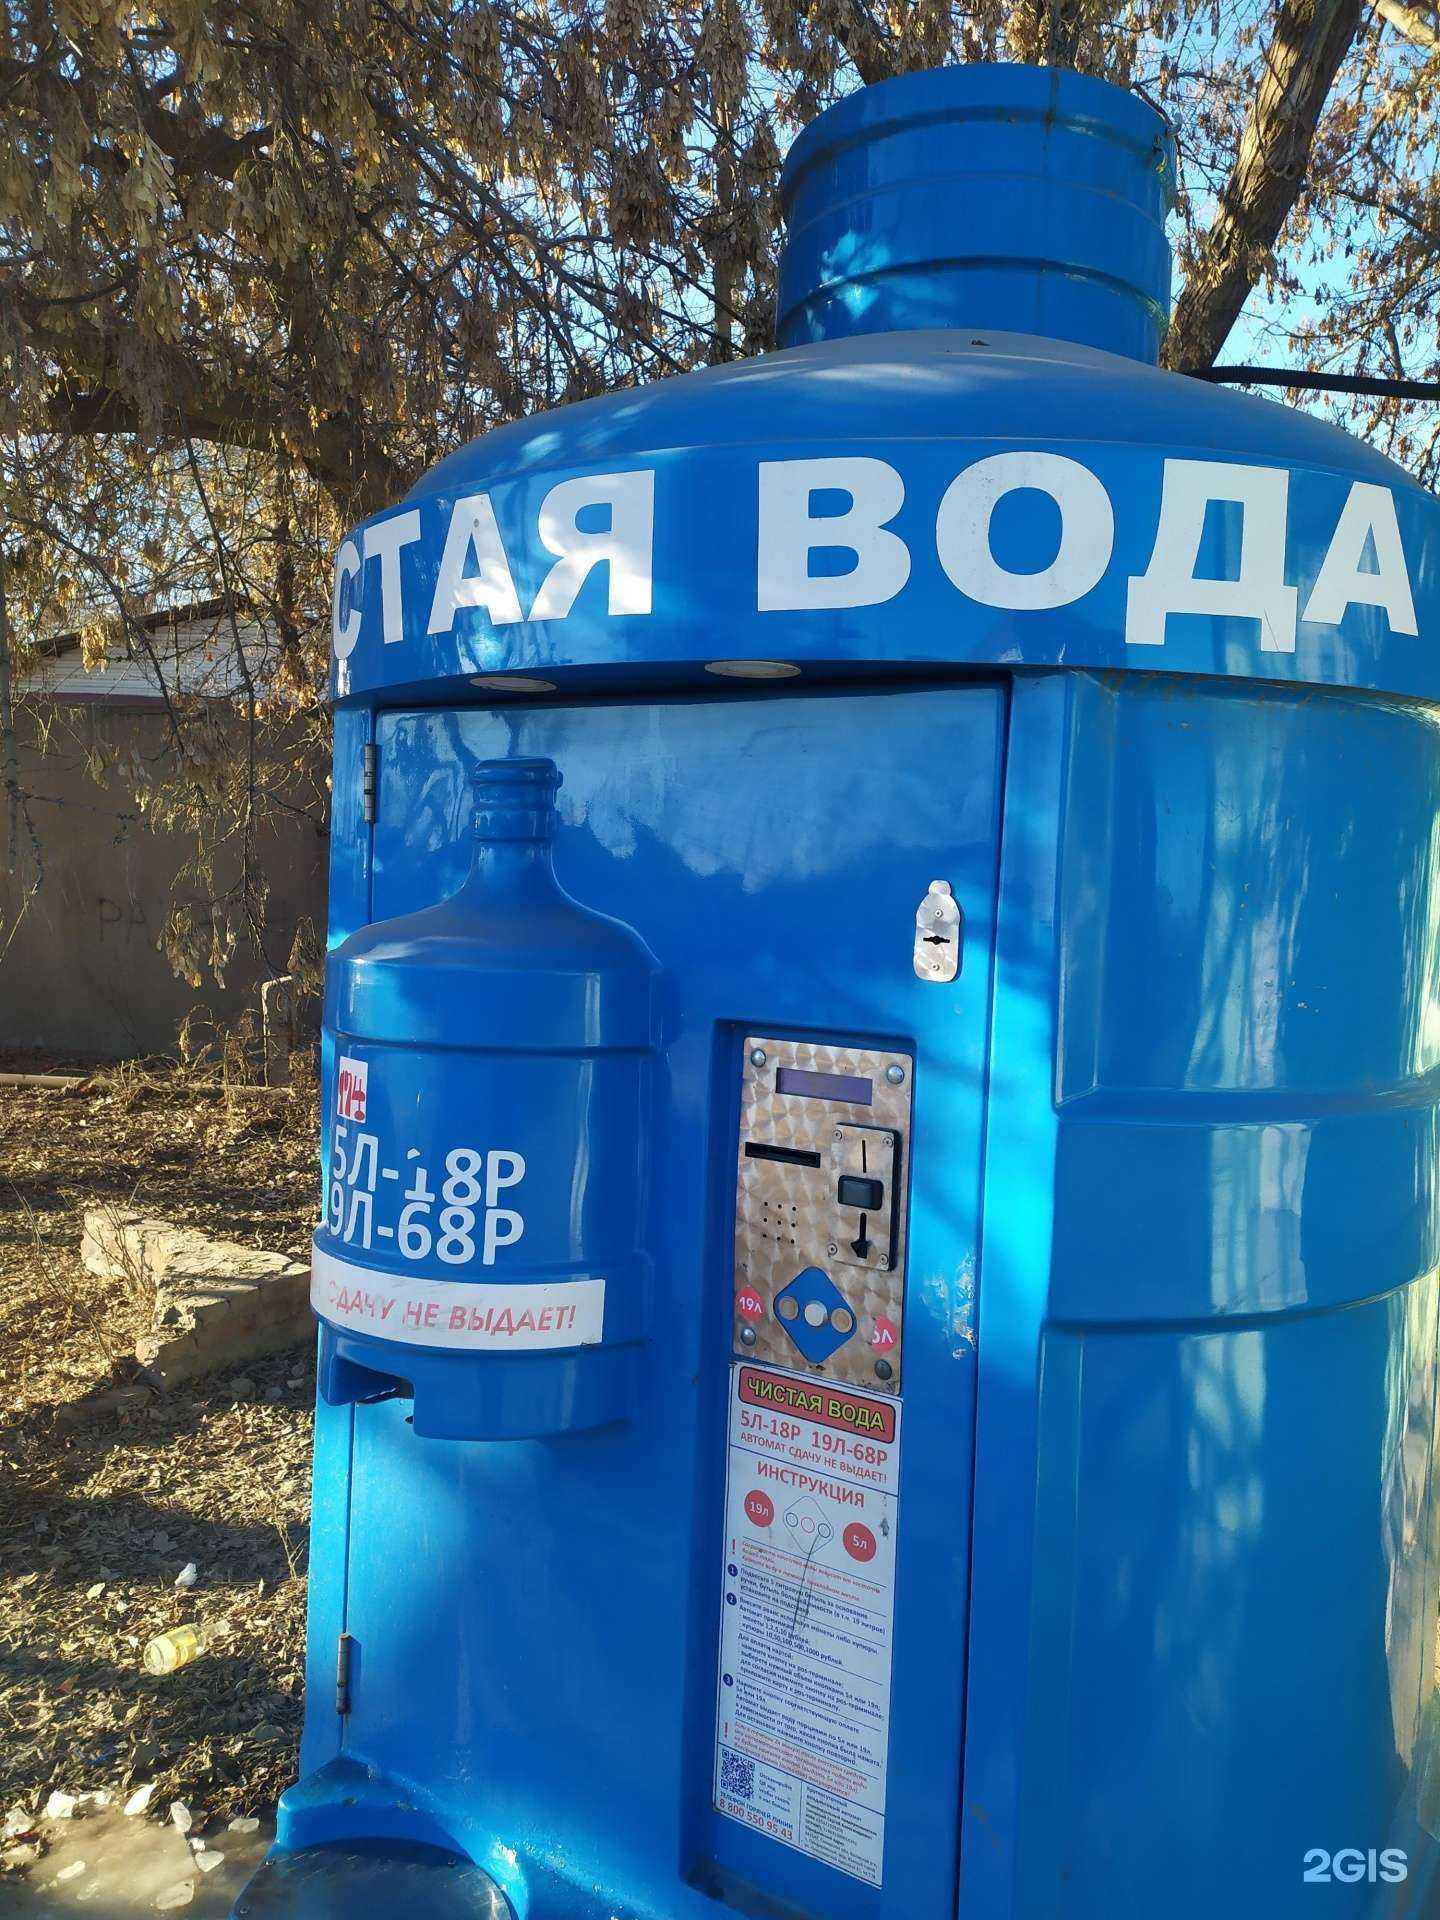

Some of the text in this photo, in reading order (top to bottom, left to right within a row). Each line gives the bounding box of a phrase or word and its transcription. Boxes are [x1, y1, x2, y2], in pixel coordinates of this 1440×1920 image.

[757, 452, 1418, 653] ВОДА
[403, 1300, 440, 1330] НЕ
[449, 1305, 577, 1336] ВЫДАЕТ!
[748, 1376, 885, 1435] ЧИСТАЯ ВОДА
[740, 1409, 888, 1468] 5Л-18Р 19Л-68Р
[740, 1431, 886, 1484] АВТОМАТ СДАЧУ НЕ ВЫДАЕТ!
[749, 1499, 768, 1517] 19л
[757, 1460, 864, 1509] ИНСТРУКЦИЯ
[852, 1534, 868, 1550] 5л
[719, 1797, 724, 1808] 8
[780, 1826, 792, 1840] 43
